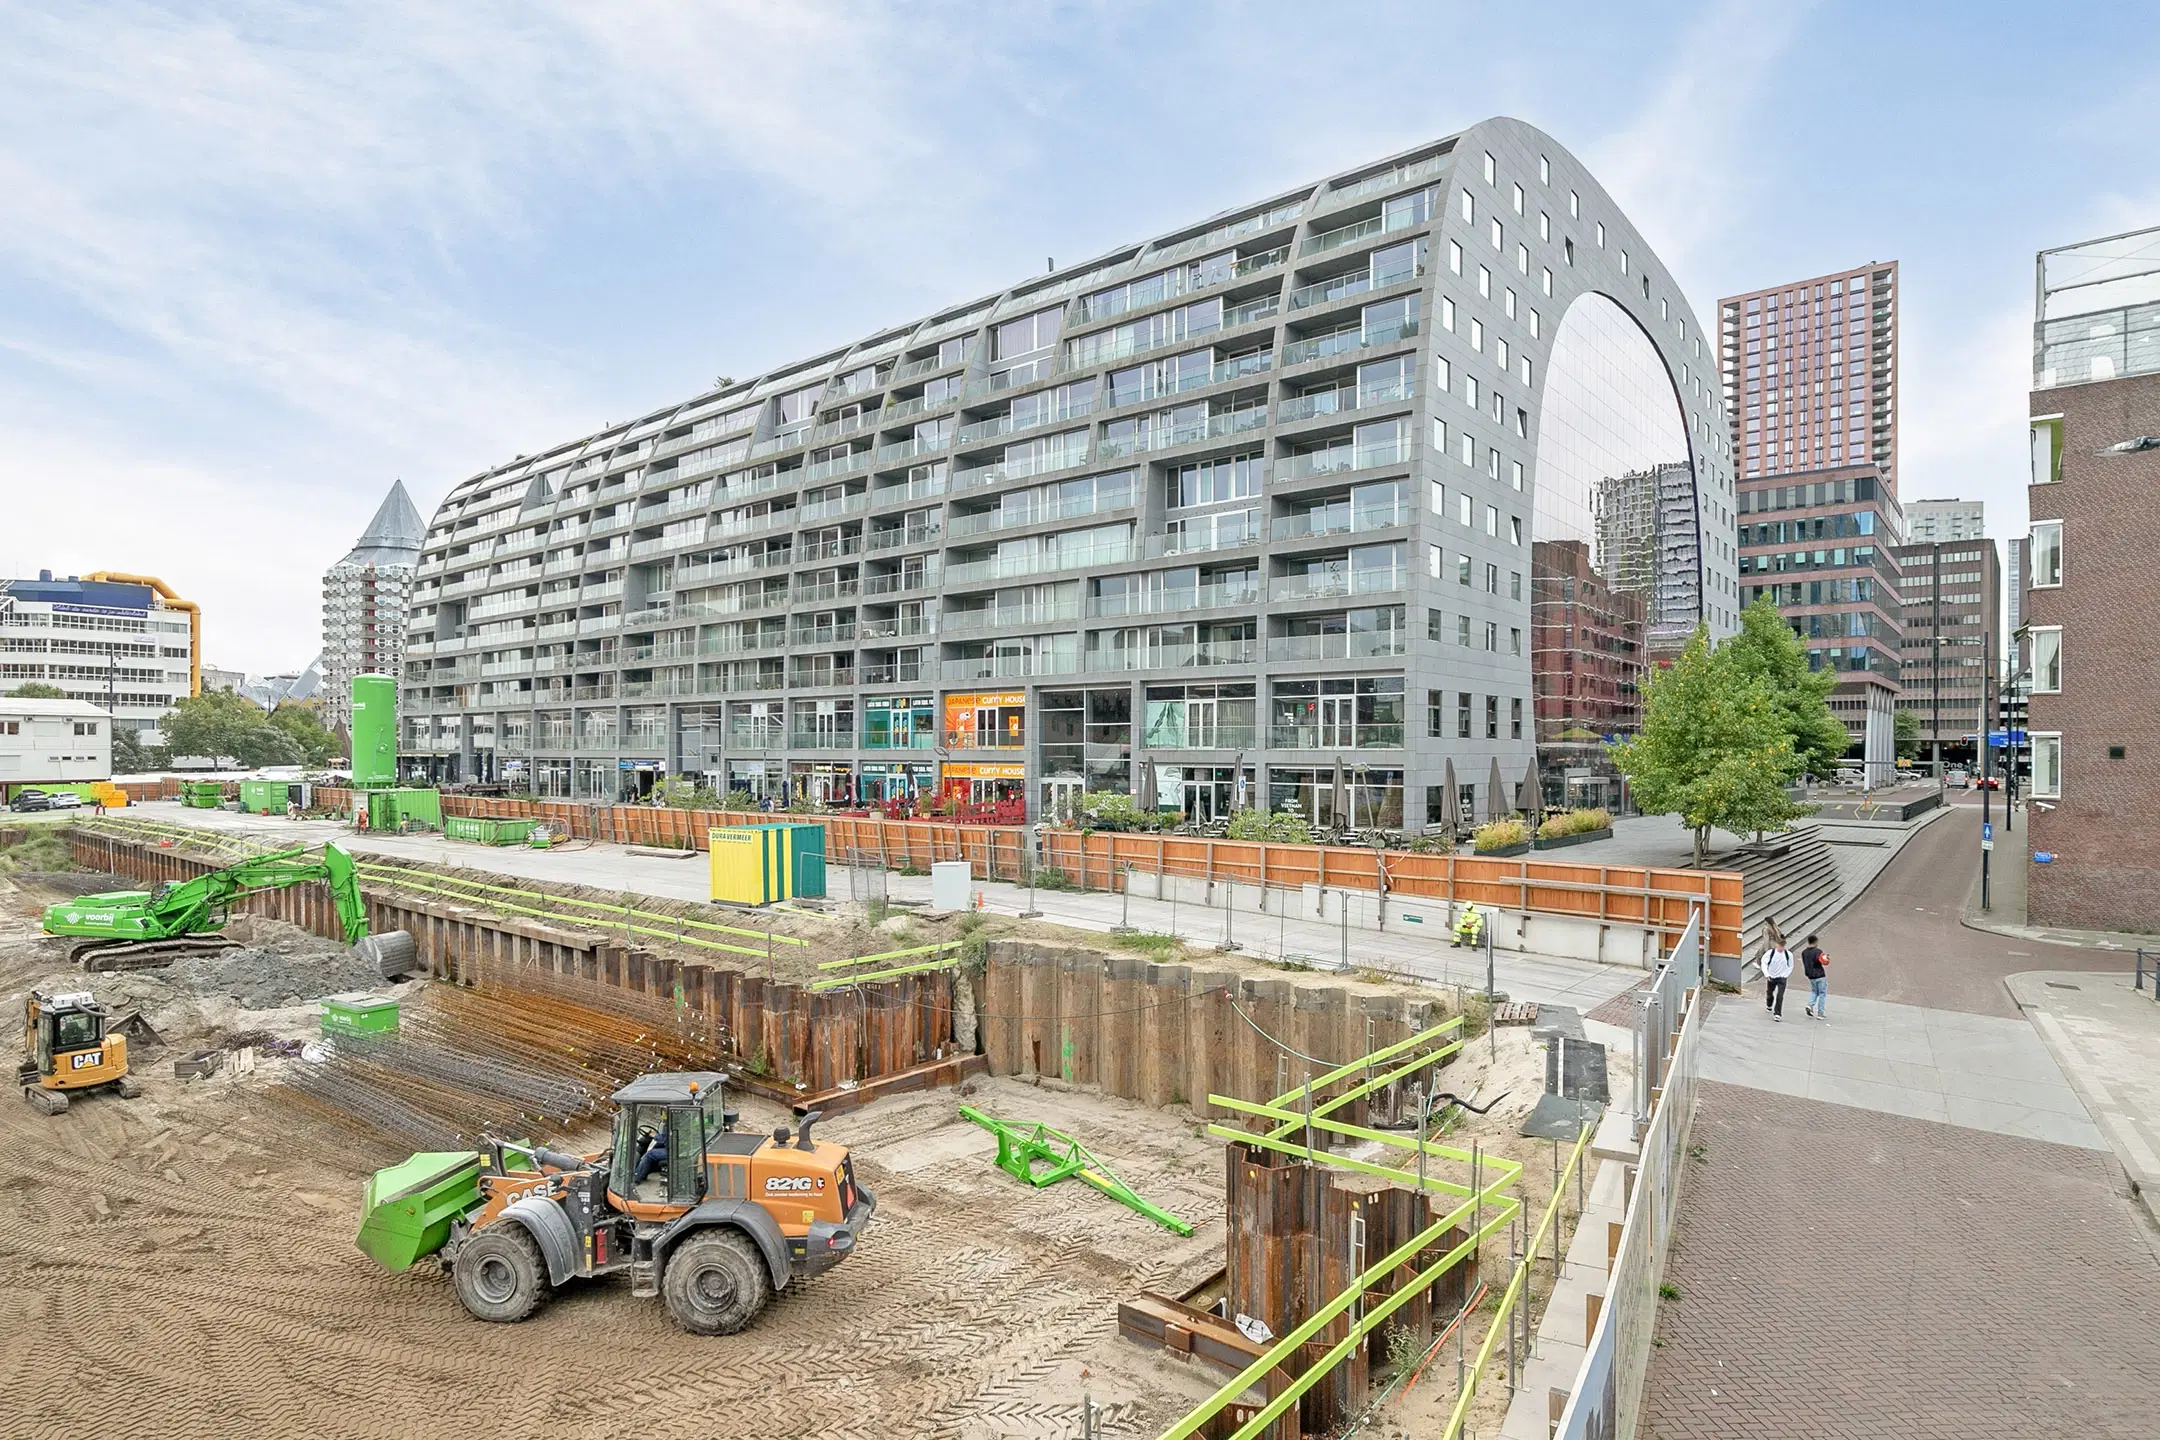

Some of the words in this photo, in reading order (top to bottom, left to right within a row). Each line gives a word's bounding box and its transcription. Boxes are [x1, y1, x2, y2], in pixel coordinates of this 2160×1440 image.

[86, 913, 114, 923] voorbij
[74, 1051, 101, 1069] CAT
[765, 1177, 812, 1191] 821G
[507, 1180, 558, 1207] CASE
